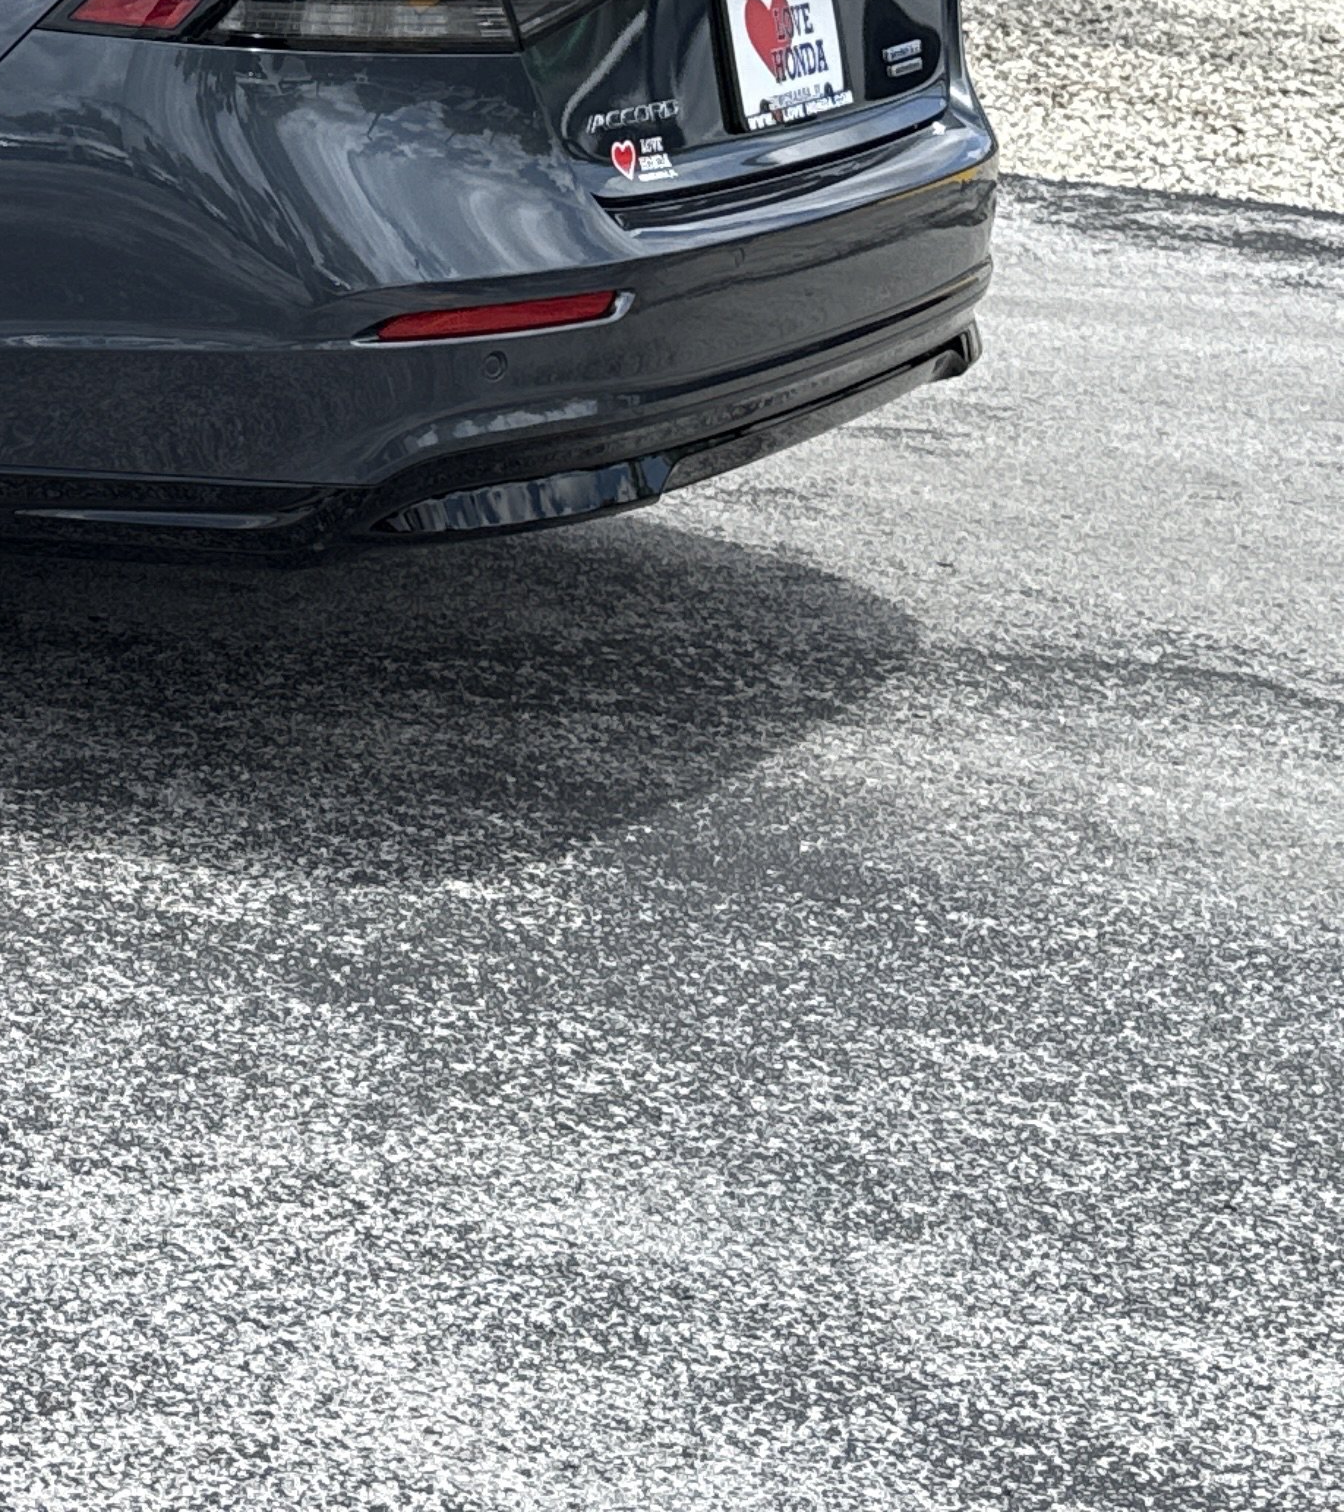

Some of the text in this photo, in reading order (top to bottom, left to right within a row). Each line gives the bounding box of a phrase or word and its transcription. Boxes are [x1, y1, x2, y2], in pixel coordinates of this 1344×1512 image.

[772, 2, 815, 43] LOVE
[770, 38, 830, 85] HONDA
[585, 98, 680, 134] ACCORD
